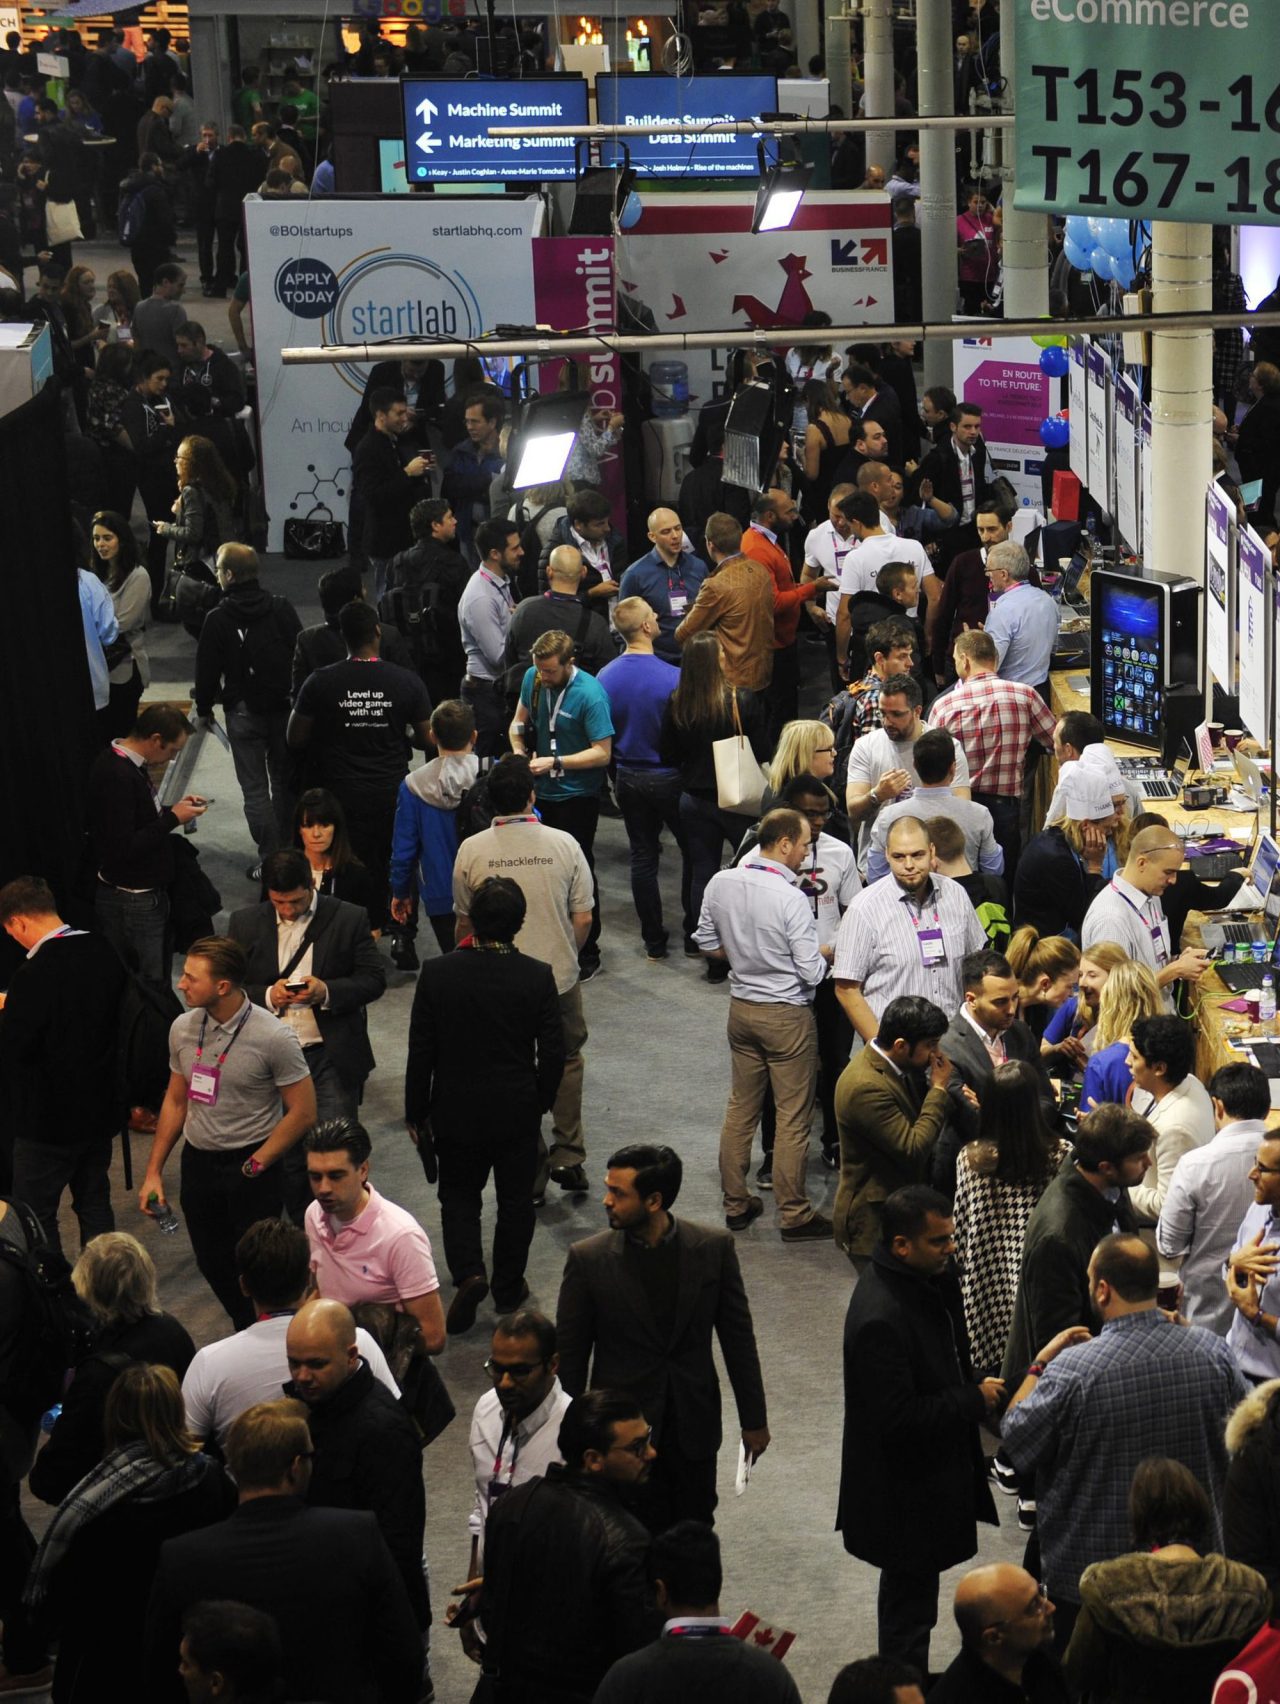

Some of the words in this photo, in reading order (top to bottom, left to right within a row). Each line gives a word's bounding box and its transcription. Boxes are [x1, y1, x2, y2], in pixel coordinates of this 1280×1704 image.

[1031, 0, 1249, 29] eCommerce
[448, 103, 507, 117] Machine
[509, 103, 562, 116] Summit
[625, 115, 680, 126] Builders
[449, 135, 520, 150] Marketing
[452, 168, 472, 177] Justin
[502, 167, 537, 175] Anne-Marie
[432, 225, 523, 238] startlabhq.com
[284, 273, 331, 286] APPLY
[284, 291, 335, 304] TODAY
[352, 300, 457, 336] startlab
[1003, 369, 1013, 378] EN
[1015, 371, 1042, 381] ROUTE
[978, 378, 991, 387] TO
[992, 379, 1008, 389] THE
[1009, 382, 1042, 391] FUTURE:
[291, 418, 312, 433] An
[318, 418, 352, 433] Incu
[347, 690, 371, 699] Level
[372, 691, 384, 701] up
[339, 699, 363, 708] video
[365, 700, 393, 710] games
[349, 708, 369, 717] with
[370, 708, 384, 717] us!
[488, 856, 553, 868] #shacklefree
